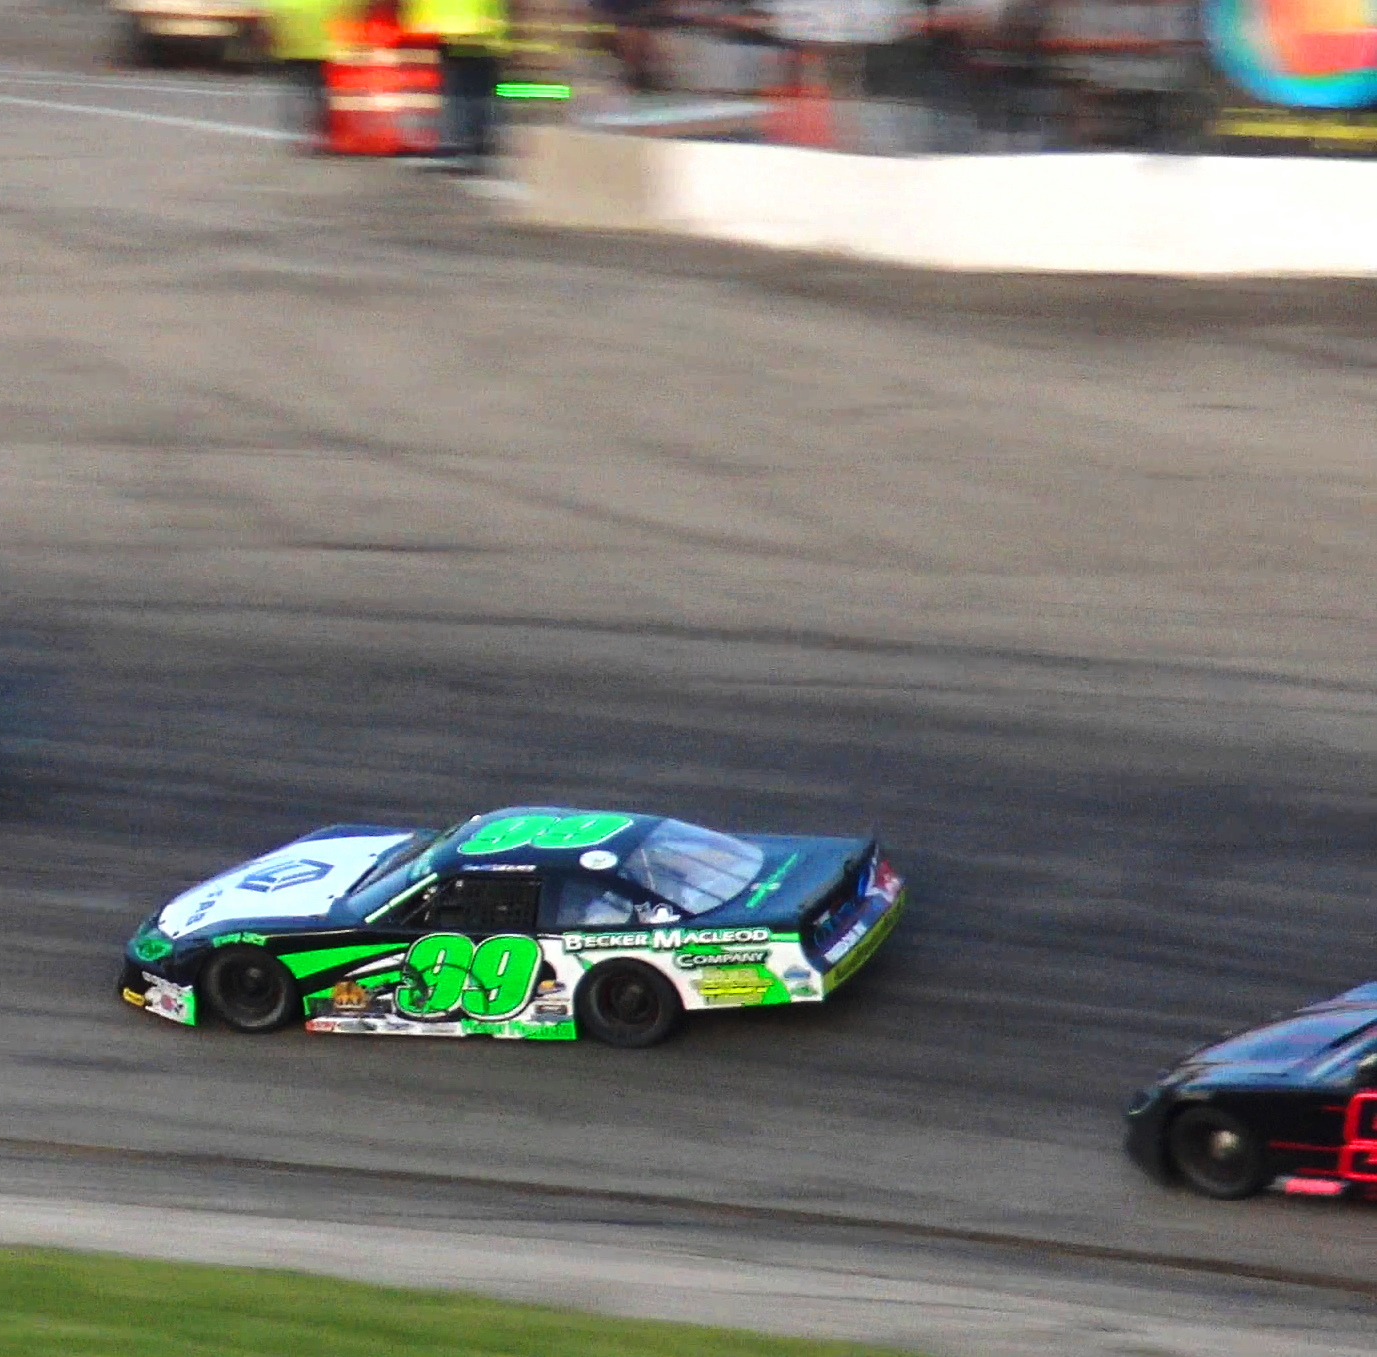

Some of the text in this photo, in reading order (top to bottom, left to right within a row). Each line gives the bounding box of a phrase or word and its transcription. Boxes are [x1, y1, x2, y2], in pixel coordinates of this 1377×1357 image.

[457, 814, 634, 855] 99
[564, 931, 648, 950] BECKER
[676, 951, 766, 970] COMPANY
[395, 932, 542, 1020] 99
